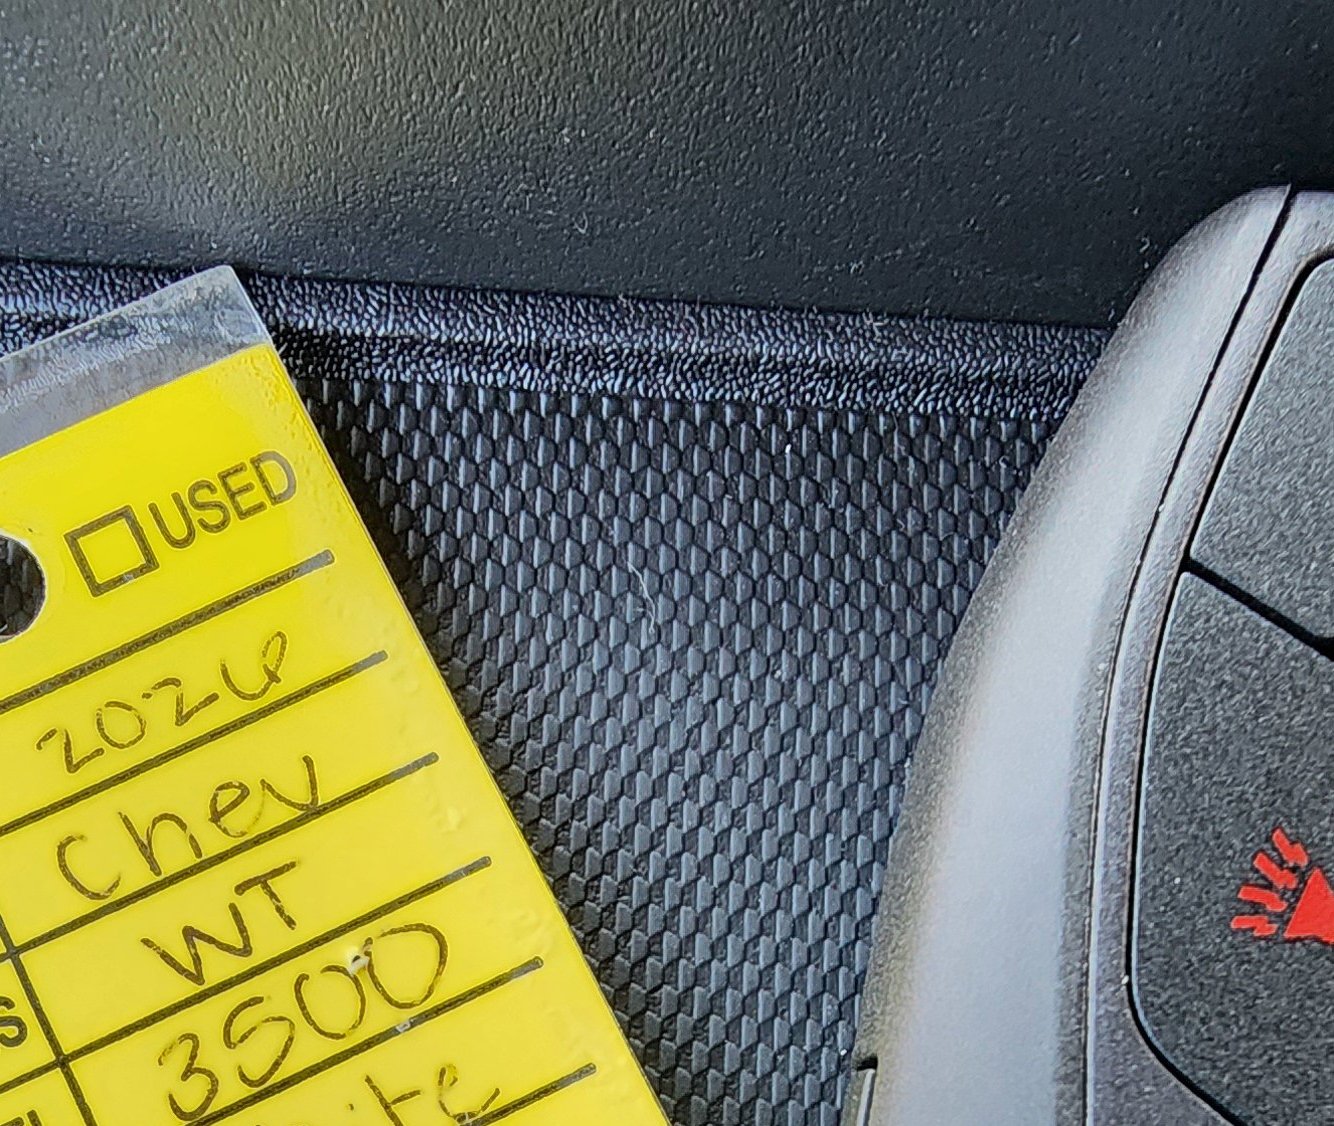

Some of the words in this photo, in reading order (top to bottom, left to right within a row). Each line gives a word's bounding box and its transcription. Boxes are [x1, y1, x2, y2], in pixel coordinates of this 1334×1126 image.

[152, 449, 297, 549] USED
[141, 860, 301, 986] WT
[158, 922, 446, 1122] 3500
